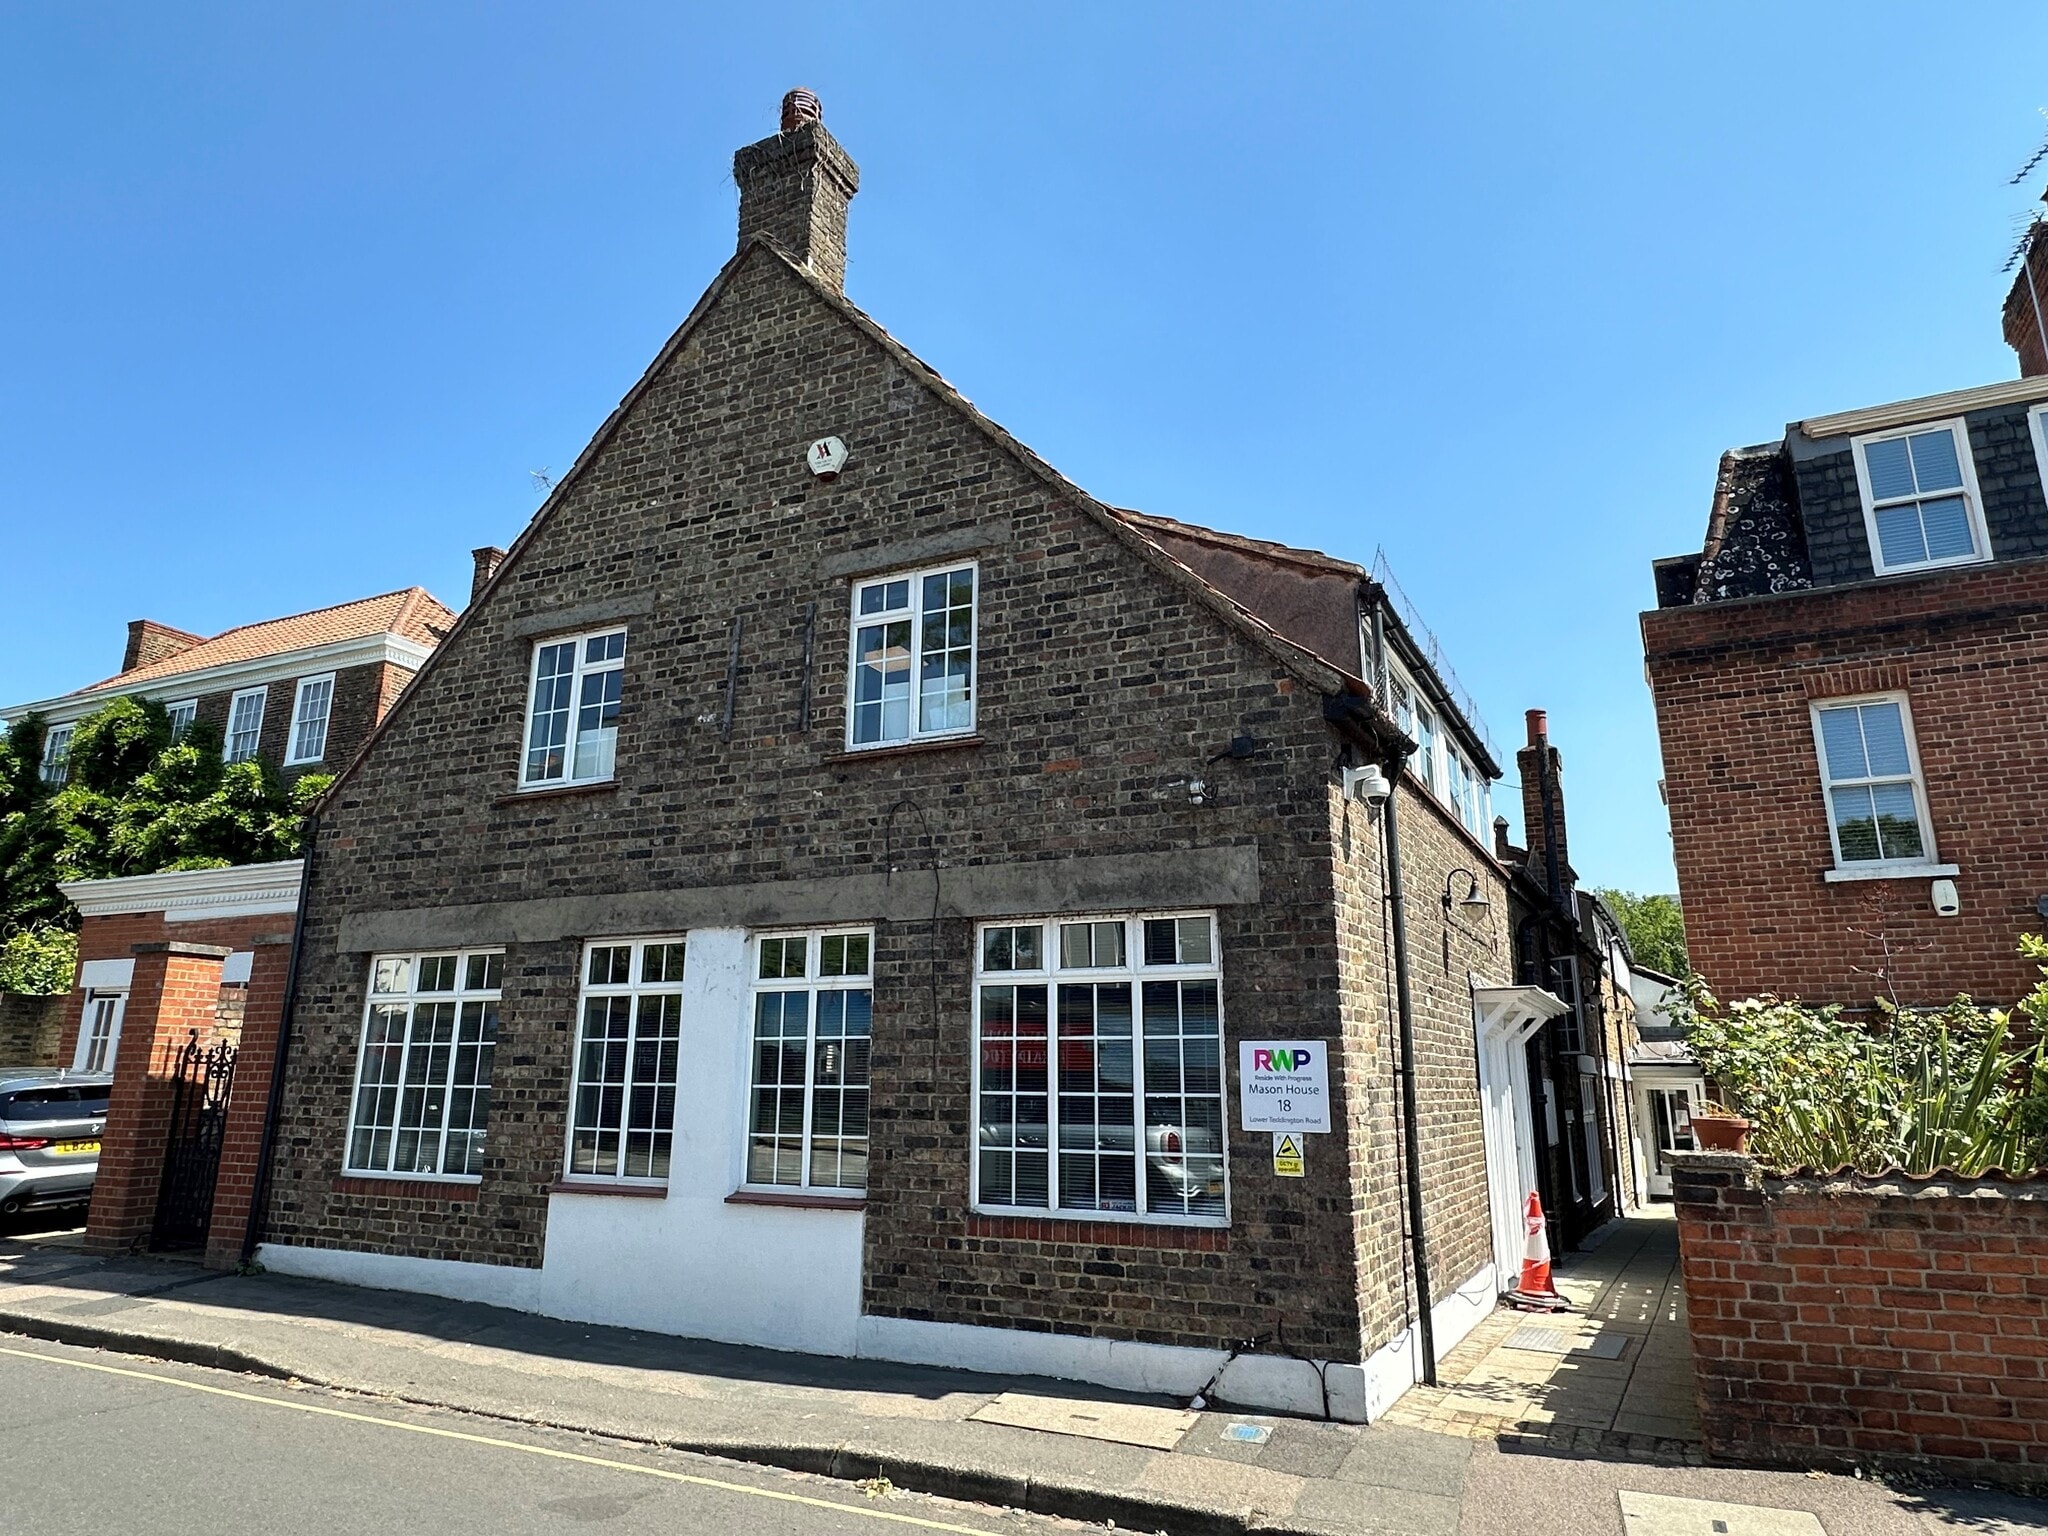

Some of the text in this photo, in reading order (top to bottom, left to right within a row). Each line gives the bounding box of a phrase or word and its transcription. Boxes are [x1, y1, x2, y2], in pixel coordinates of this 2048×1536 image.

[1254, 1049, 1311, 1072] RWP
[1249, 1084, 1319, 1095] Mason House
[1277, 1099, 1292, 1112] 18
[1269, 1117, 1304, 1125] Teddington
[64, 1141, 94, 1152] LB23
